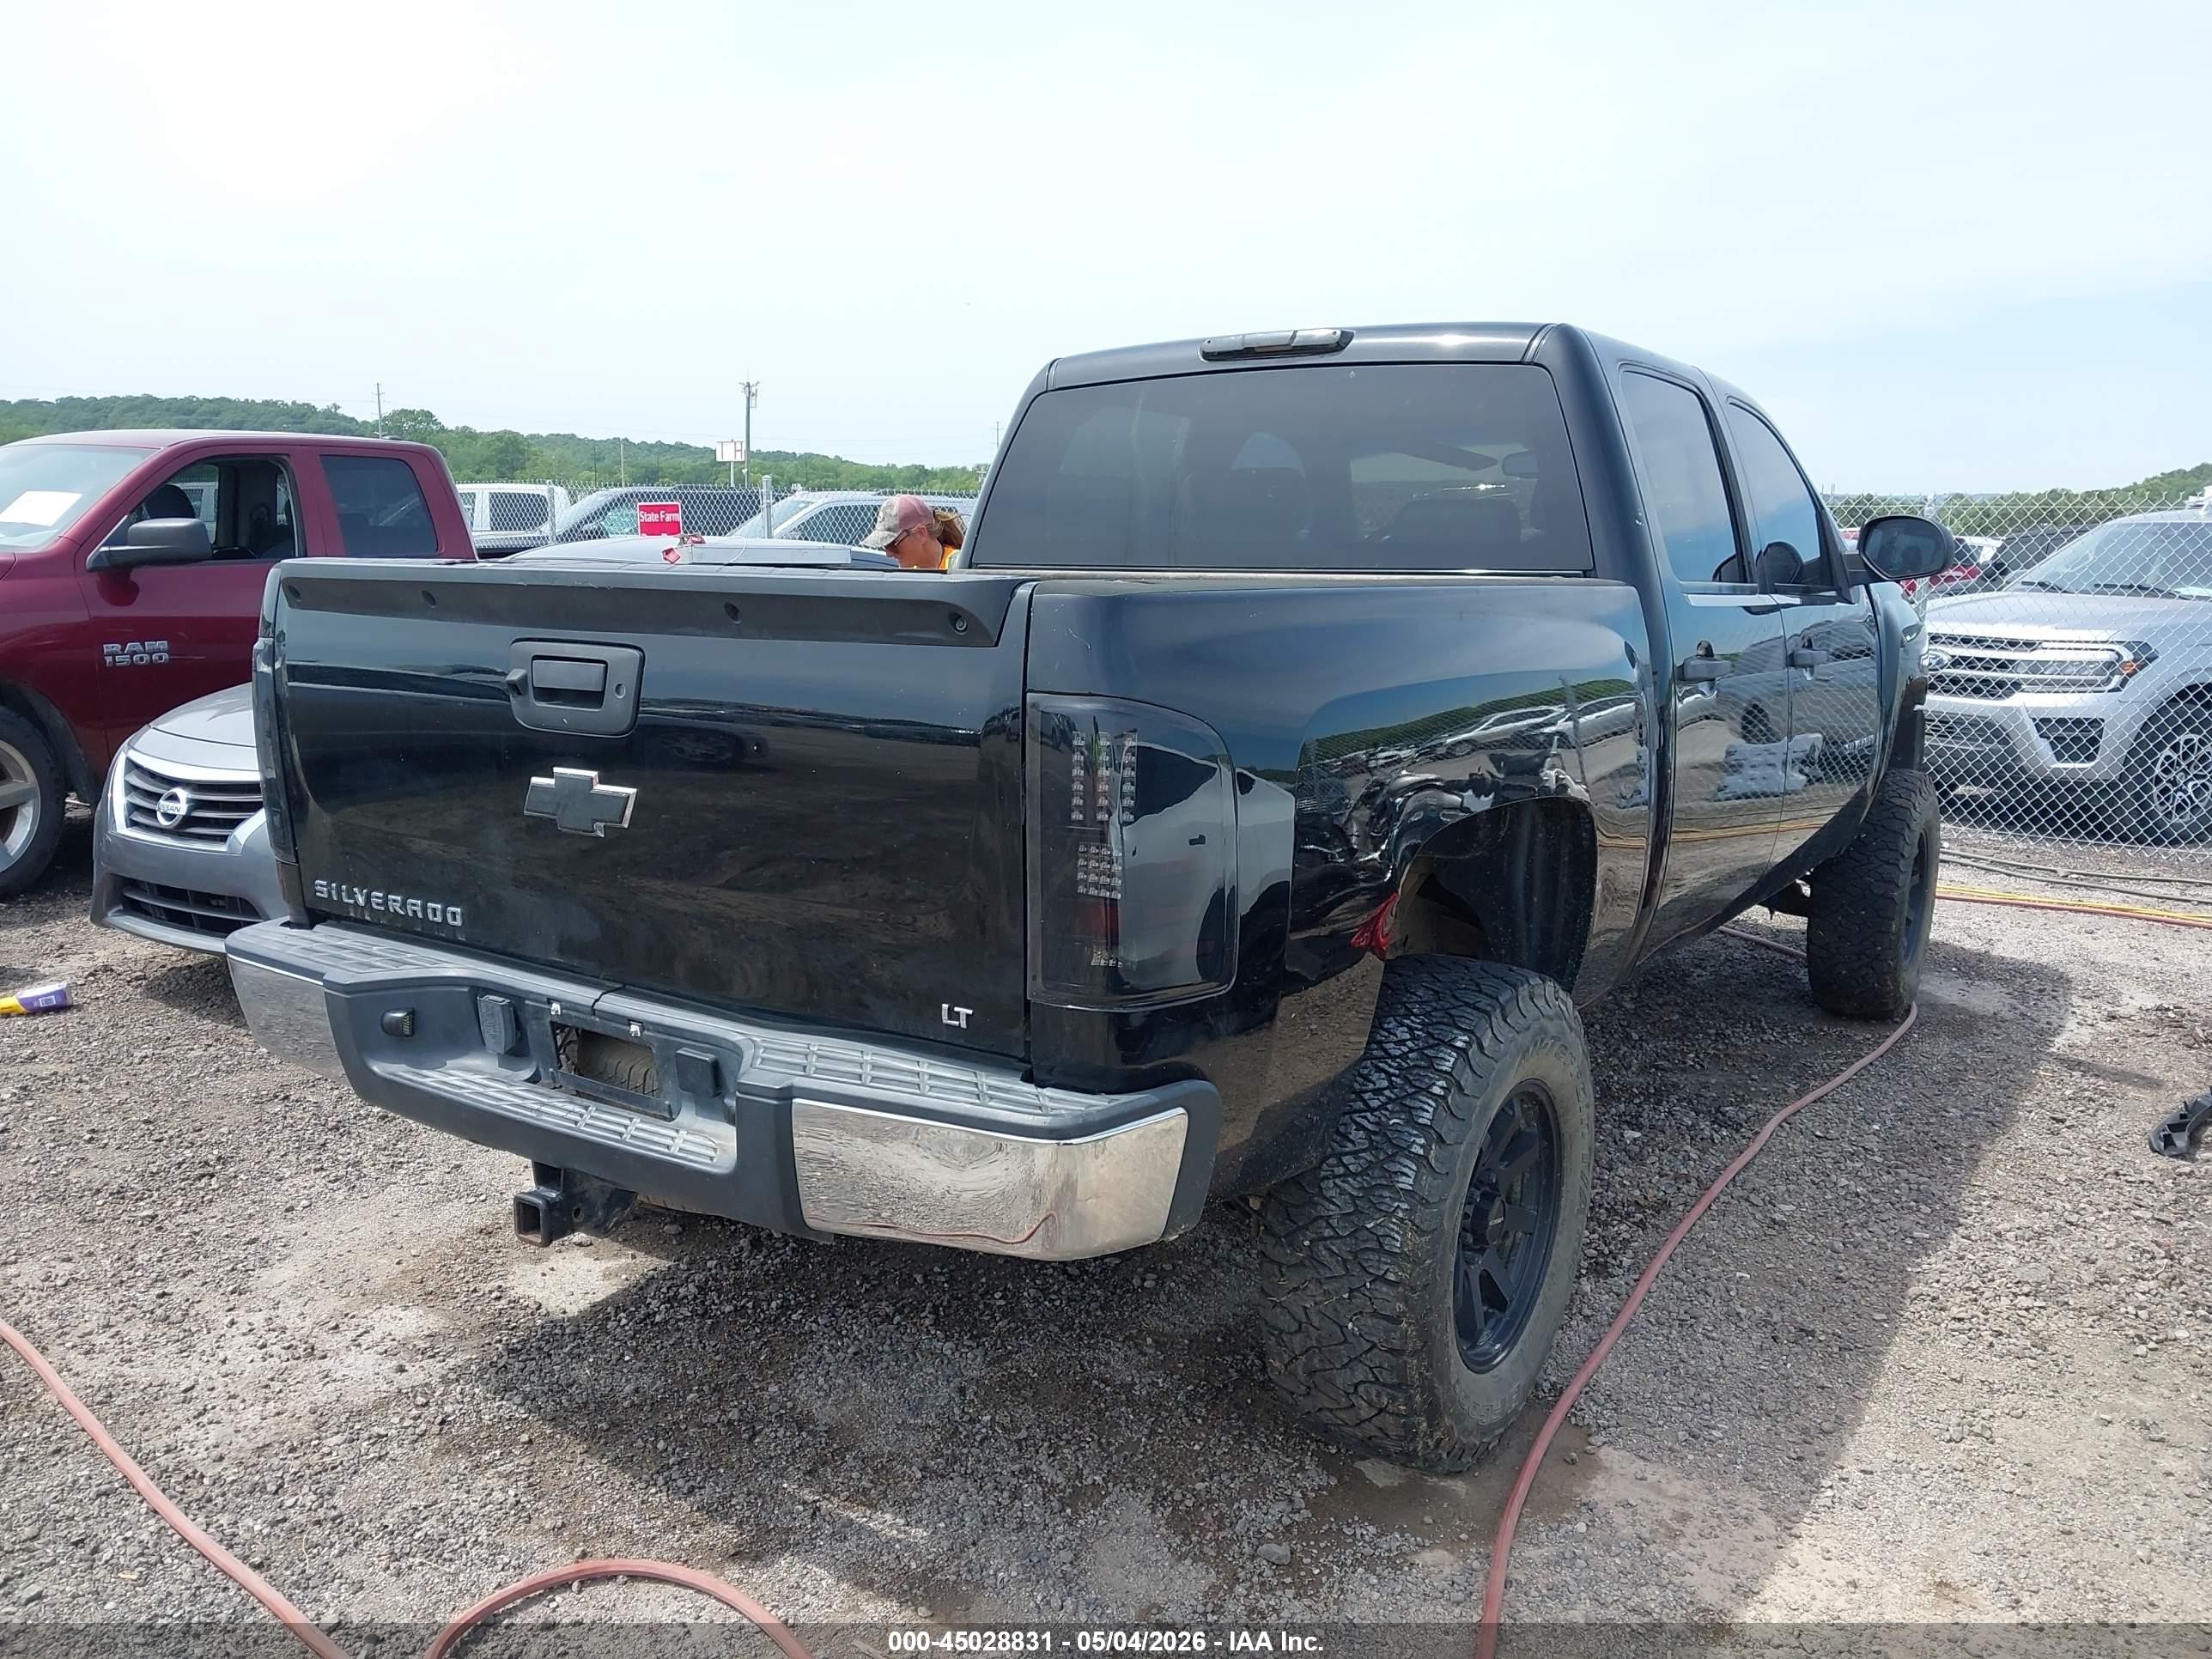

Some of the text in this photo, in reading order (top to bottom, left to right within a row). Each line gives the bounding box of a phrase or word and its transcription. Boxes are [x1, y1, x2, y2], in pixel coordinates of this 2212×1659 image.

[640, 510, 680, 522] State Farm
[103, 641, 168, 654] RAM
[105, 653, 169, 666] 1500
[314, 879, 464, 927] SILVERADO
[942, 1003, 973, 1029] LT
